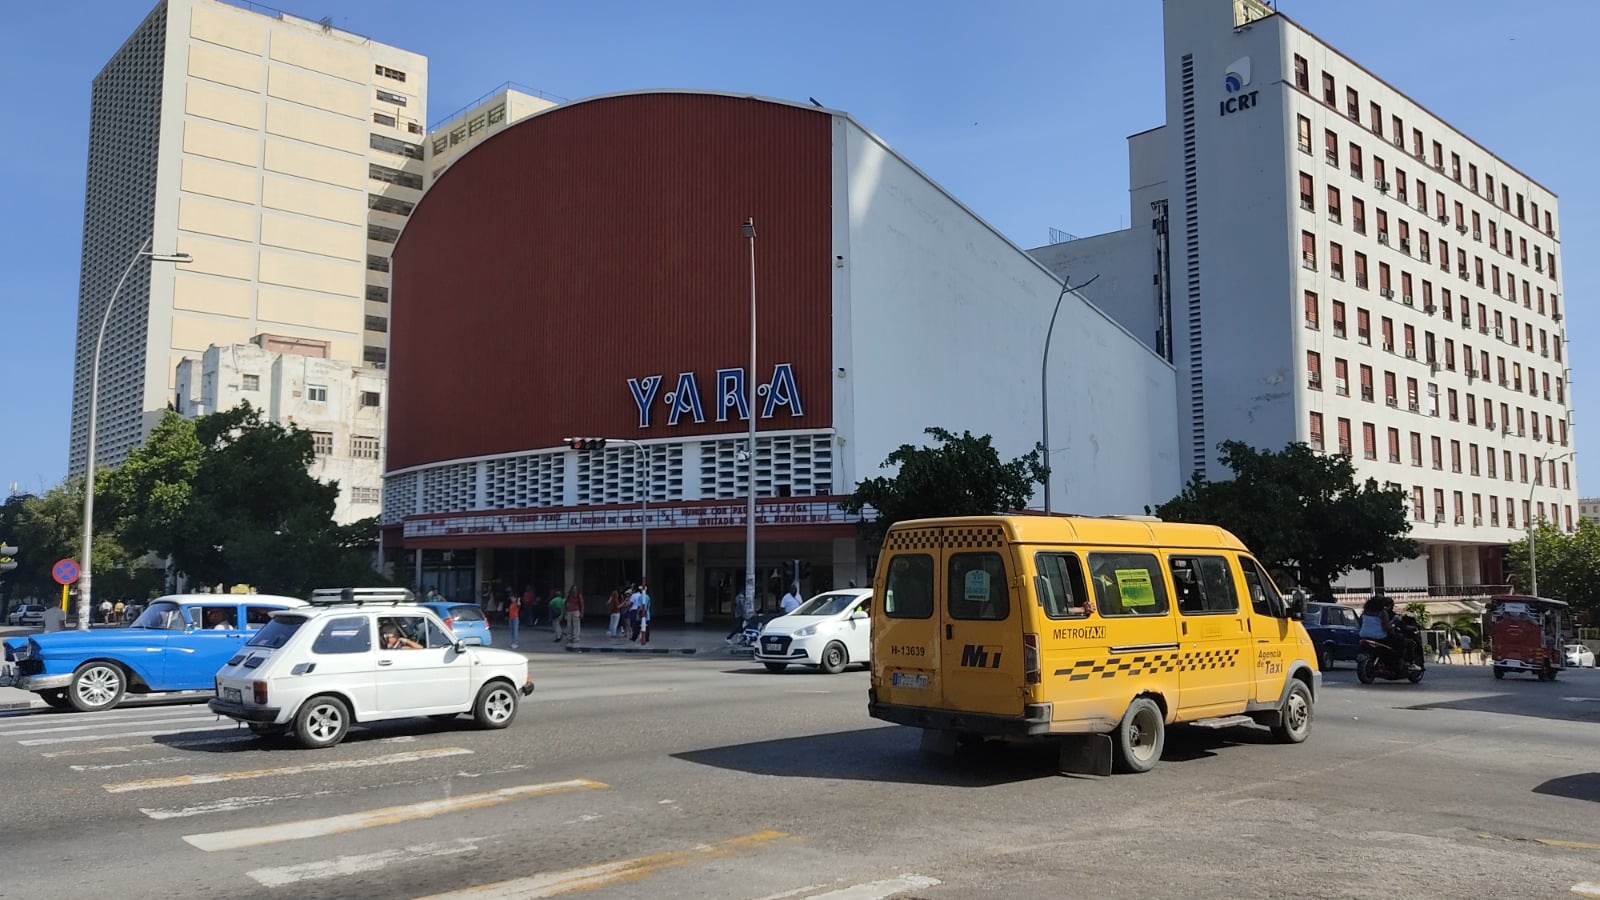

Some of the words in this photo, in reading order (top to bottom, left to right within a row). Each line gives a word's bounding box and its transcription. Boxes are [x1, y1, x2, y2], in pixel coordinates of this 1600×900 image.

[1220, 91, 1258, 116] ICRT
[627, 363, 804, 428] YARA
[1053, 625, 1106, 640] METROTAXI
[891, 645, 925, 656] H-13639
[1257, 649, 1282, 660] Agencia
[1256, 660, 1264, 668] de
[1265, 659, 1284, 675] Taxi
